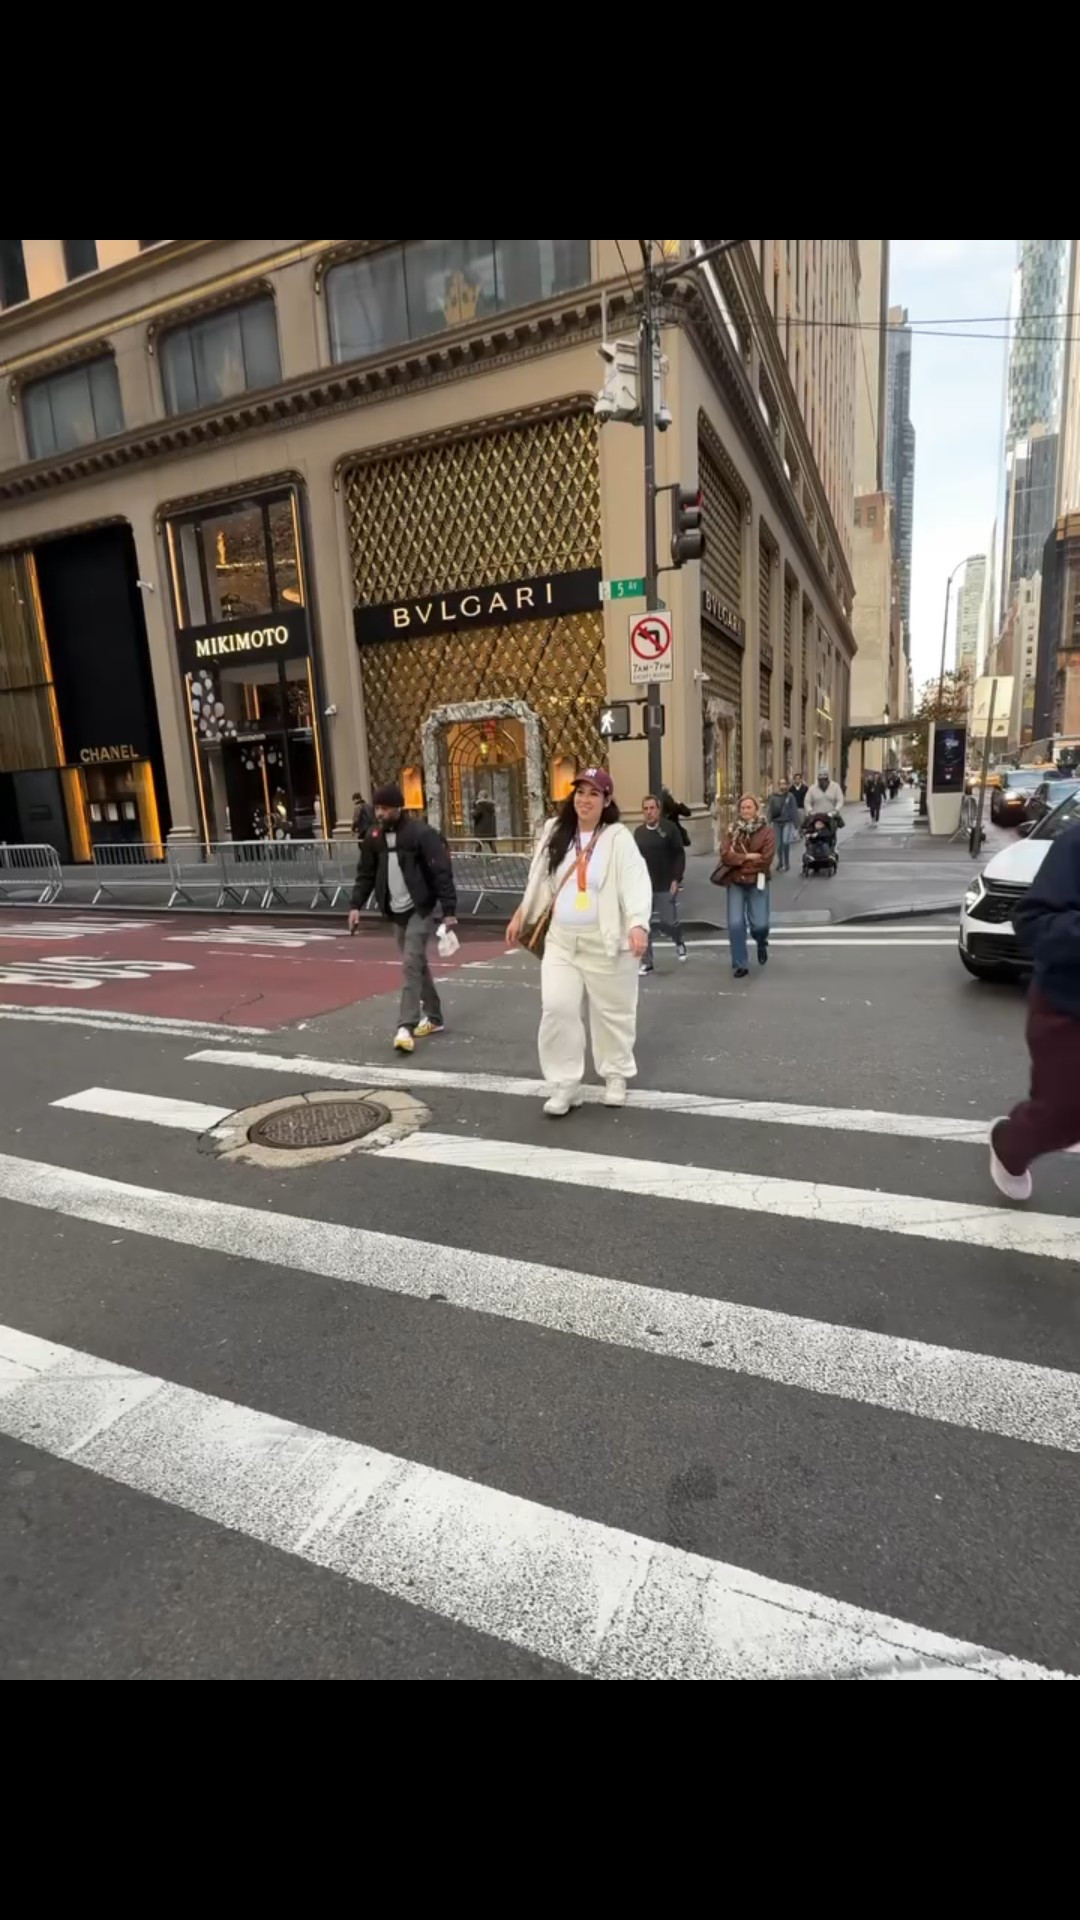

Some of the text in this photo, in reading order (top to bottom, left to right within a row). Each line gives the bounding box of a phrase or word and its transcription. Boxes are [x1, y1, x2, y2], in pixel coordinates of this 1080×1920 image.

[617, 582, 625, 597] 5
[393, 583, 552, 628] BVLGARI
[195, 625, 288, 657] MIKIMOTO
[80, 744, 139, 762] CHANEL
